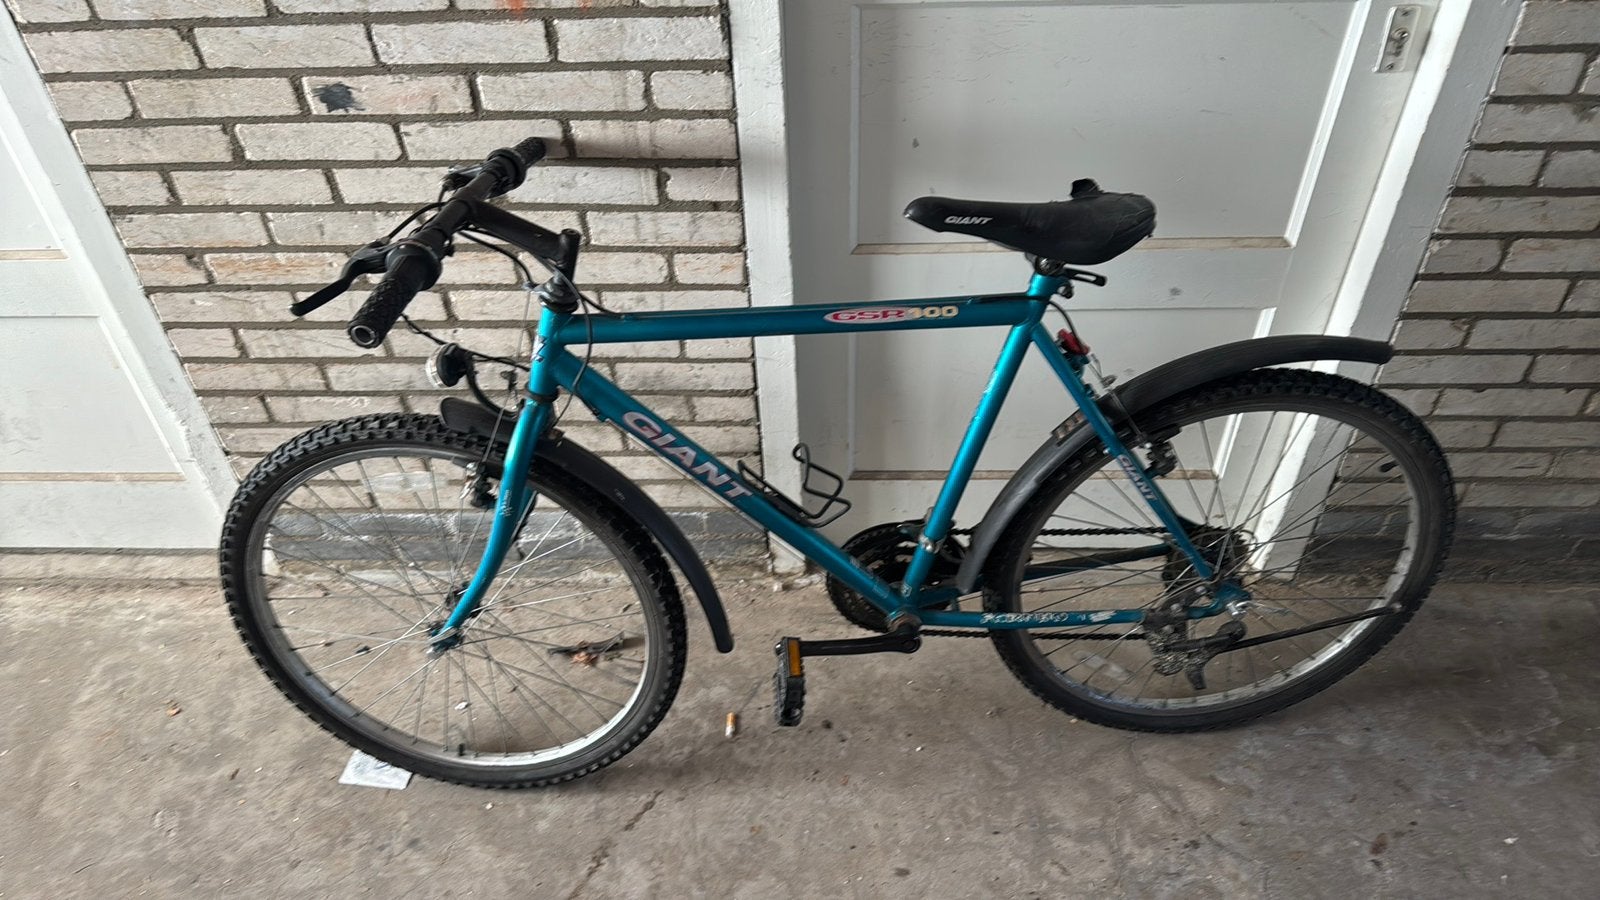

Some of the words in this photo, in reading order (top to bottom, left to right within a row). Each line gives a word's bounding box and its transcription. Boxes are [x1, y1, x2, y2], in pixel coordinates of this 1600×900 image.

[944, 215, 993, 225] GIANT
[832, 309, 905, 321] GSR
[622, 411, 753, 499] GIANT
[1118, 453, 1157, 501] GIANT
